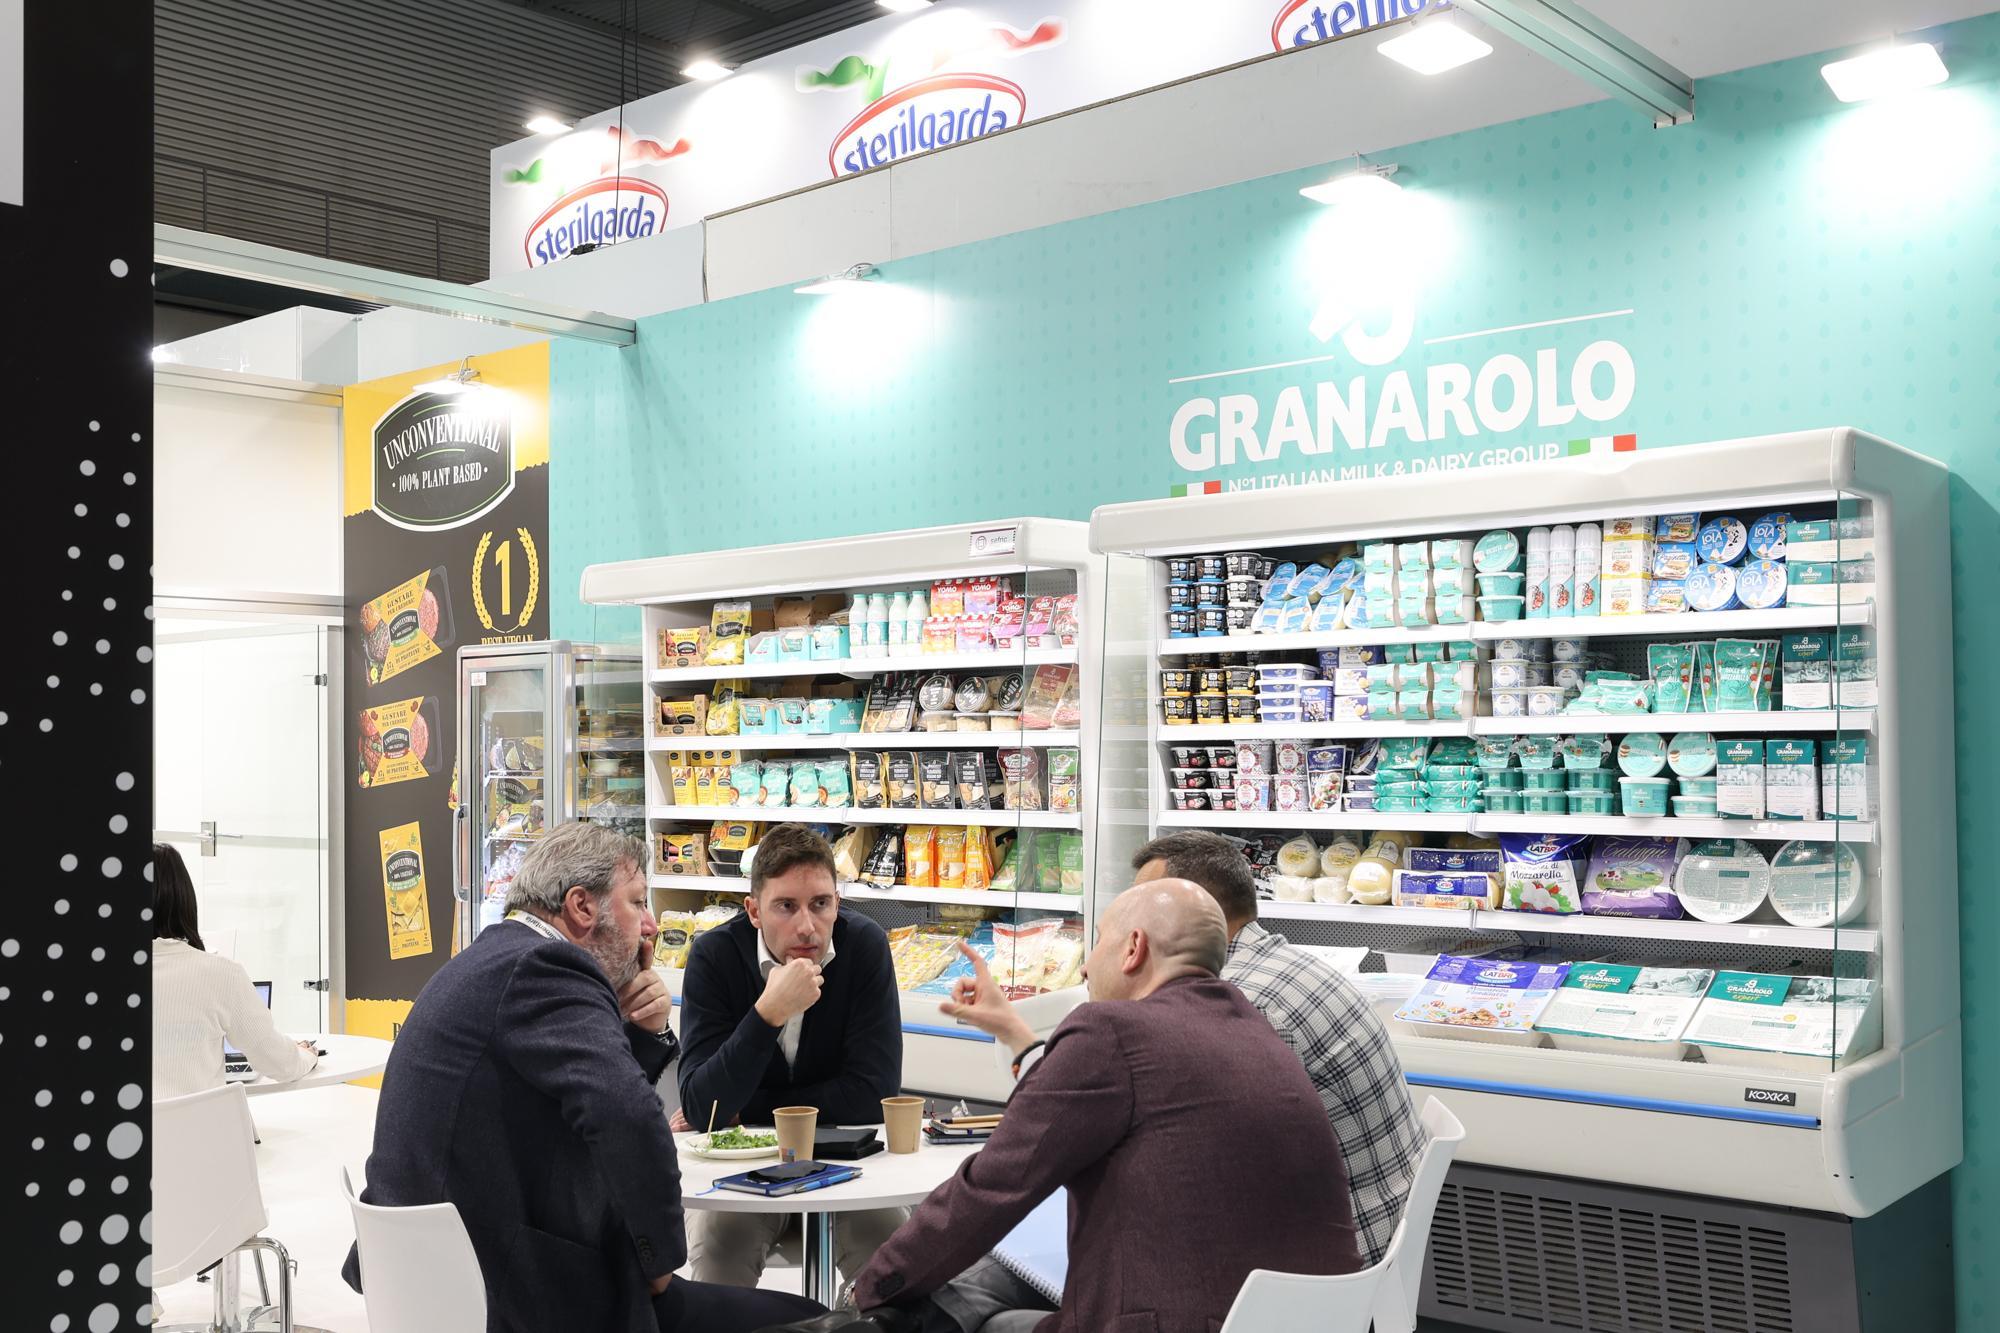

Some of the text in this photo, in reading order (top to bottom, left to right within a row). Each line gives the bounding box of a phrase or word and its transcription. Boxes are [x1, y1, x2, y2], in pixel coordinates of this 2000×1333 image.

[1169, 340, 1636, 472] GRANAROLO
[399, 462, 482, 493] 100% PLANT BASED
[1261, 468, 1339, 490] ITALIAN
[1340, 462, 1388, 482] MILK
[1392, 460, 1406, 476] &
[1411, 452, 1474, 474] DAIRY
[1479, 443, 1560, 467] GROUP
[495, 540, 511, 616] 1
[1510, 869, 1564, 880] Mozzarella
[1727, 985, 1774, 996] GRANAROLO
[1748, 1090, 1791, 1104] KOXKA
